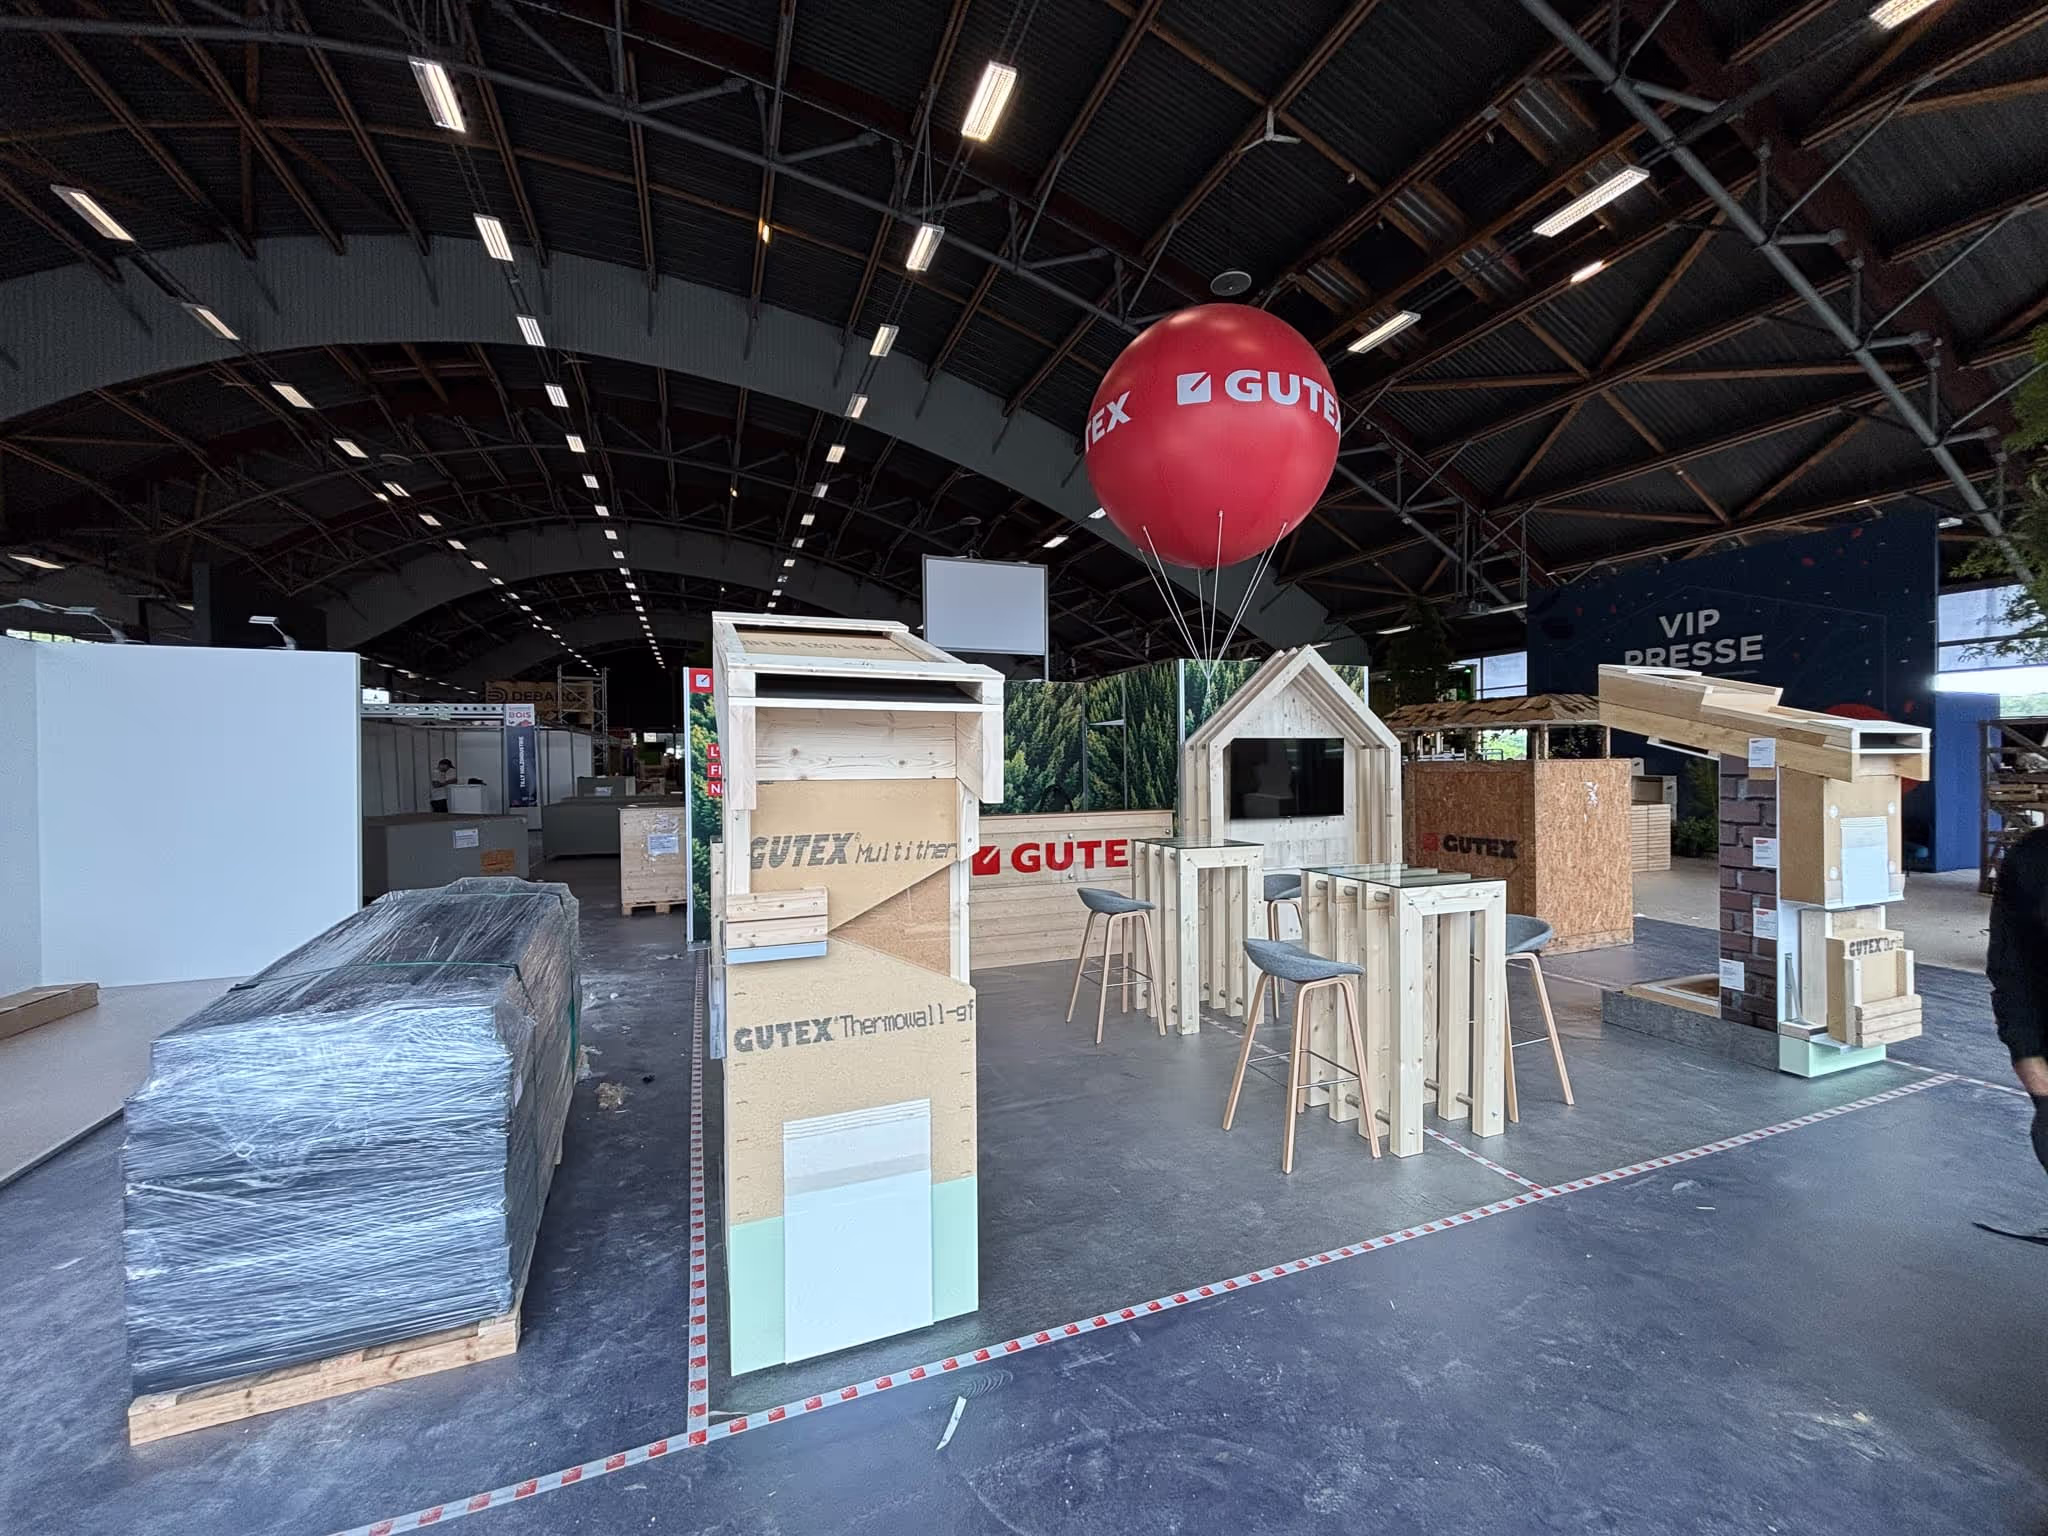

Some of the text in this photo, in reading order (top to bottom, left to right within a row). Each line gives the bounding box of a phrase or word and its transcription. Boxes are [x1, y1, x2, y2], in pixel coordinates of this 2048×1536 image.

[1658, 608, 1720, 639] VIP
[1624, 634, 1764, 668] PRESSE
[1010, 838, 1129, 873] GUTE
[1442, 833, 1518, 860] GUTEX
[1849, 937, 1881, 957] GUTEX
[840, 998, 974, 1039] Thermowall-gf
